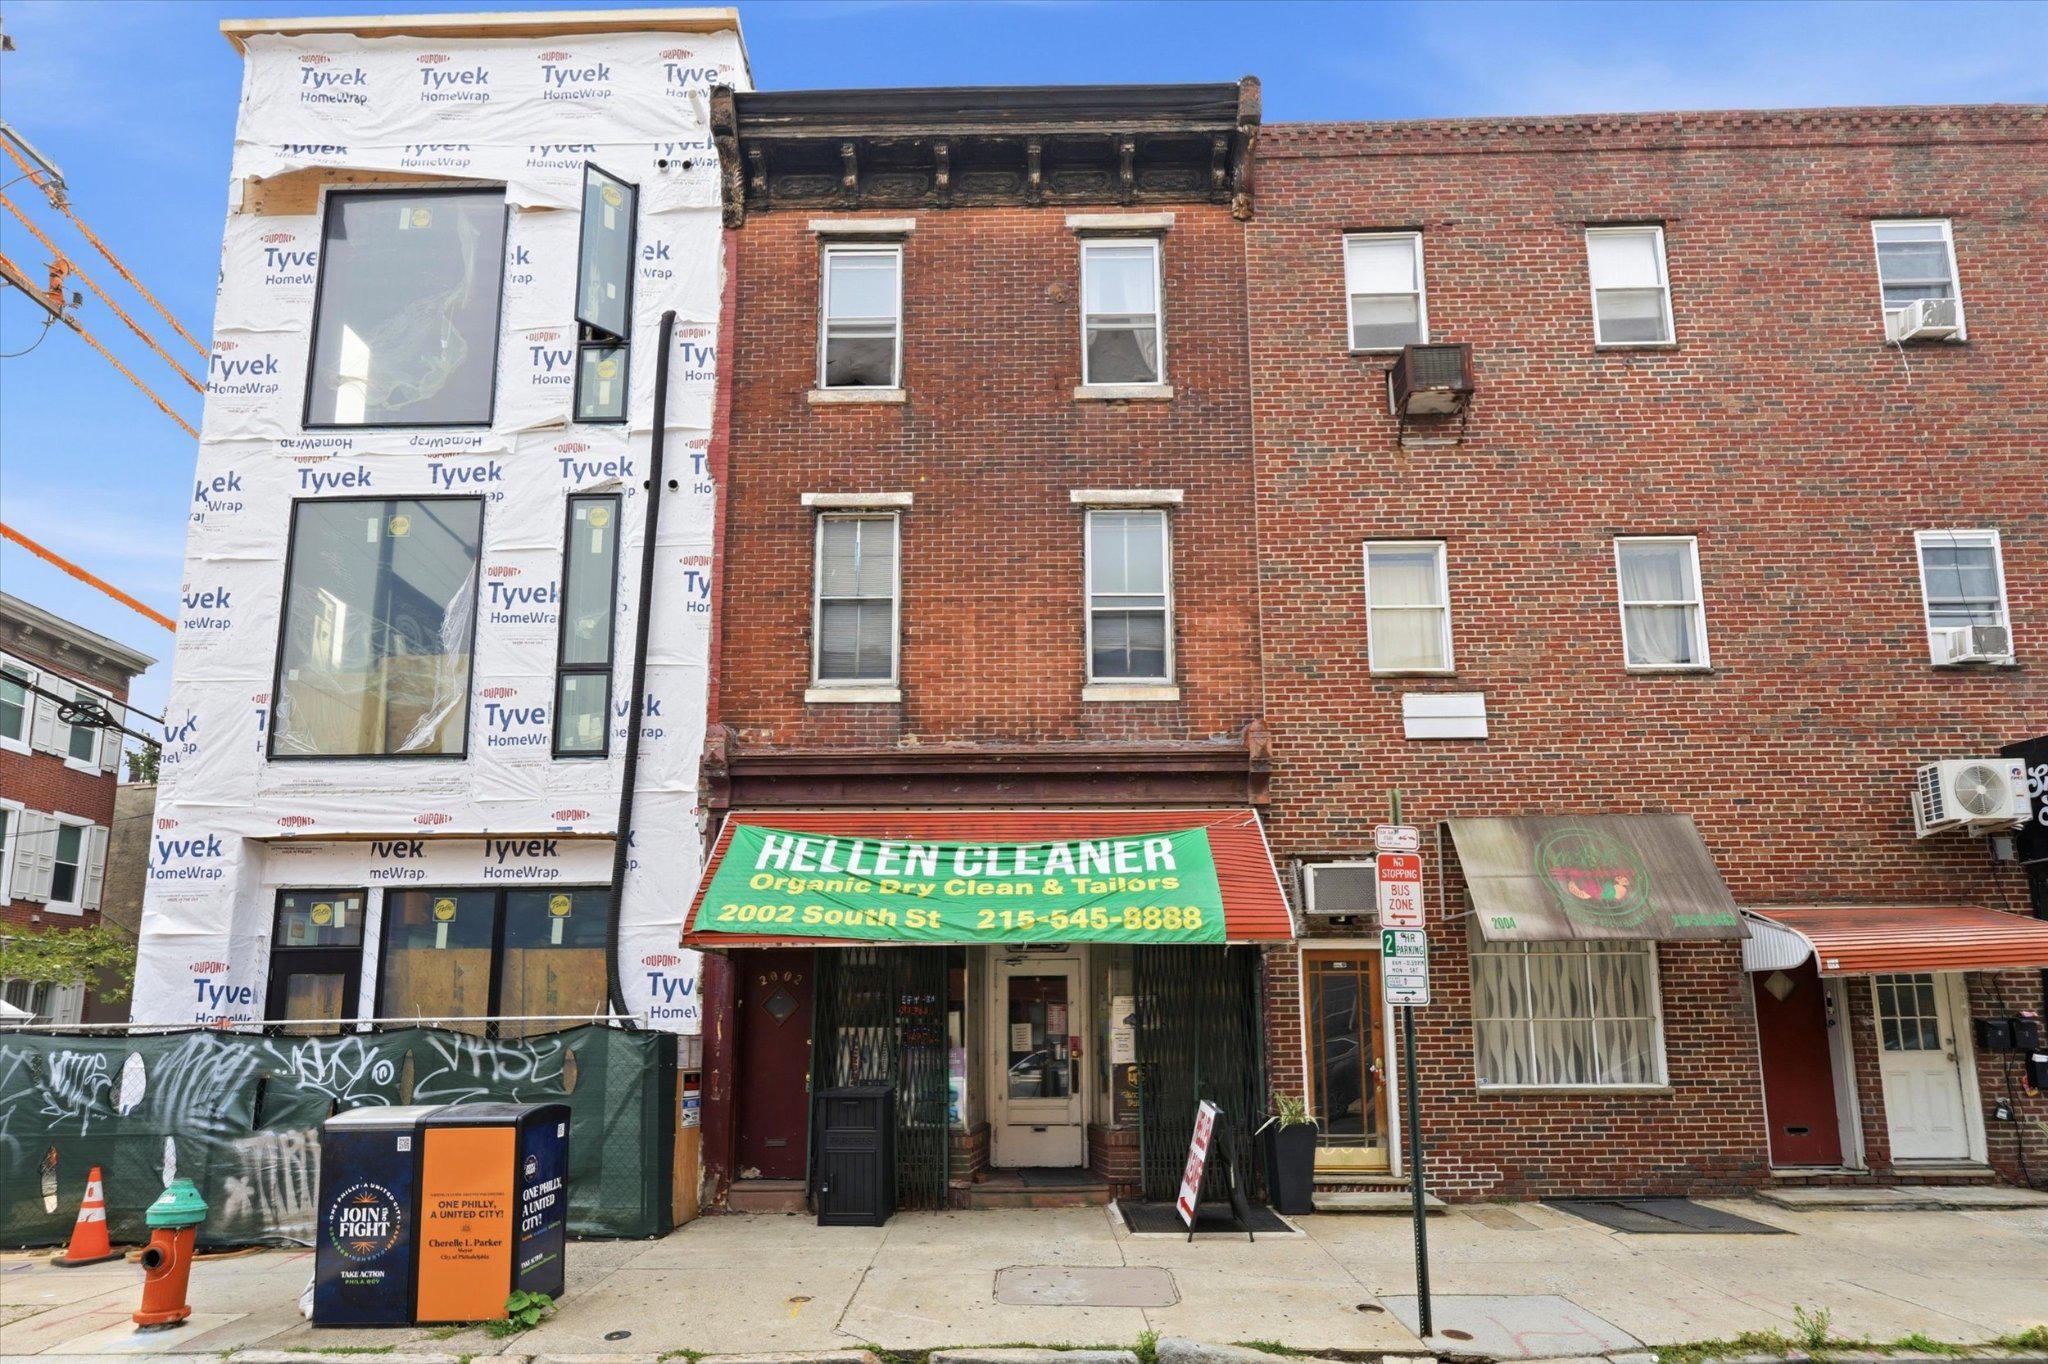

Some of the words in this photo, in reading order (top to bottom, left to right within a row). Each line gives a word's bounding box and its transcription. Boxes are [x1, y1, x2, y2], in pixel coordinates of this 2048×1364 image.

[301, 67, 367, 89] Tyvek
[420, 67, 489, 89] Tyvek
[541, 62, 610, 87] Tyvek
[421, 91, 490, 103] HomeWrap
[543, 88, 611, 100] HomeWrap
[400, 157, 471, 169] HomeWrap
[264, 248, 317, 272] Tyve
[530, 346, 572, 371] Tyv
[210, 354, 278, 381] Tyvek
[533, 374, 570, 384] Home
[206, 381, 278, 394] HomeWrap
[428, 460, 503, 489] Tyvek
[559, 456, 634, 483] Tyvek
[298, 465, 373, 494] Tyvek
[488, 566, 518, 577] DUPONT
[484, 687, 514, 698] DUPONT
[484, 703, 545, 732] Tyve
[282, 816, 311, 827] DUPONT
[418, 813, 449, 824] DUPONT
[555, 809, 586, 821] DUPONT
[754, 834, 939, 877] HELLEN
[953, 837, 1177, 876] CLEANER
[1393, 857, 1405, 868] NO
[484, 866, 559, 880] HomeWrap
[1381, 868, 1418, 879] STOPPING
[750, 873, 872, 895] Organic
[879, 879, 935, 898] Dry
[944, 878, 1034, 896] Clean
[1041, 878, 1064, 896] &
[1071, 876, 1180, 895] Tailors
[1391, 884, 1410, 896] BUS
[1389, 899, 1414, 910] ZONE
[716, 904, 796, 924] 2002
[802, 905, 898, 928] South
[904, 908, 941, 929] St
[976, 906, 1203, 931] 215-545-8888
[1384, 934, 1393, 953] 2
[1396, 945, 1424, 955] PARKING
[646, 954, 677, 966] DUPONT
[194, 961, 226, 974] DUPONT
[647, 972, 694, 1003] Tyv
[523, 1186, 538, 1202] ONE
[438, 1200, 459, 1209] ONE
[462, 1200, 497, 1209] PHILLY,
[522, 1204, 528, 1217] A
[529, 1193, 555, 1213] UNITED
[340, 1207, 380, 1223] JOIN
[381, 1207, 389, 1221] the
[430, 1211, 437, 1219] A
[440, 1210, 476, 1219] UNITED
[479, 1210, 504, 1218] CITY!
[339, 1221, 391, 1237] FIGHT
[522, 1213, 542, 1232] CITY!
[429, 1239, 463, 1247] Cherelle
[474, 1239, 502, 1247] Parker
[360, 1270, 385, 1278] ACTION
